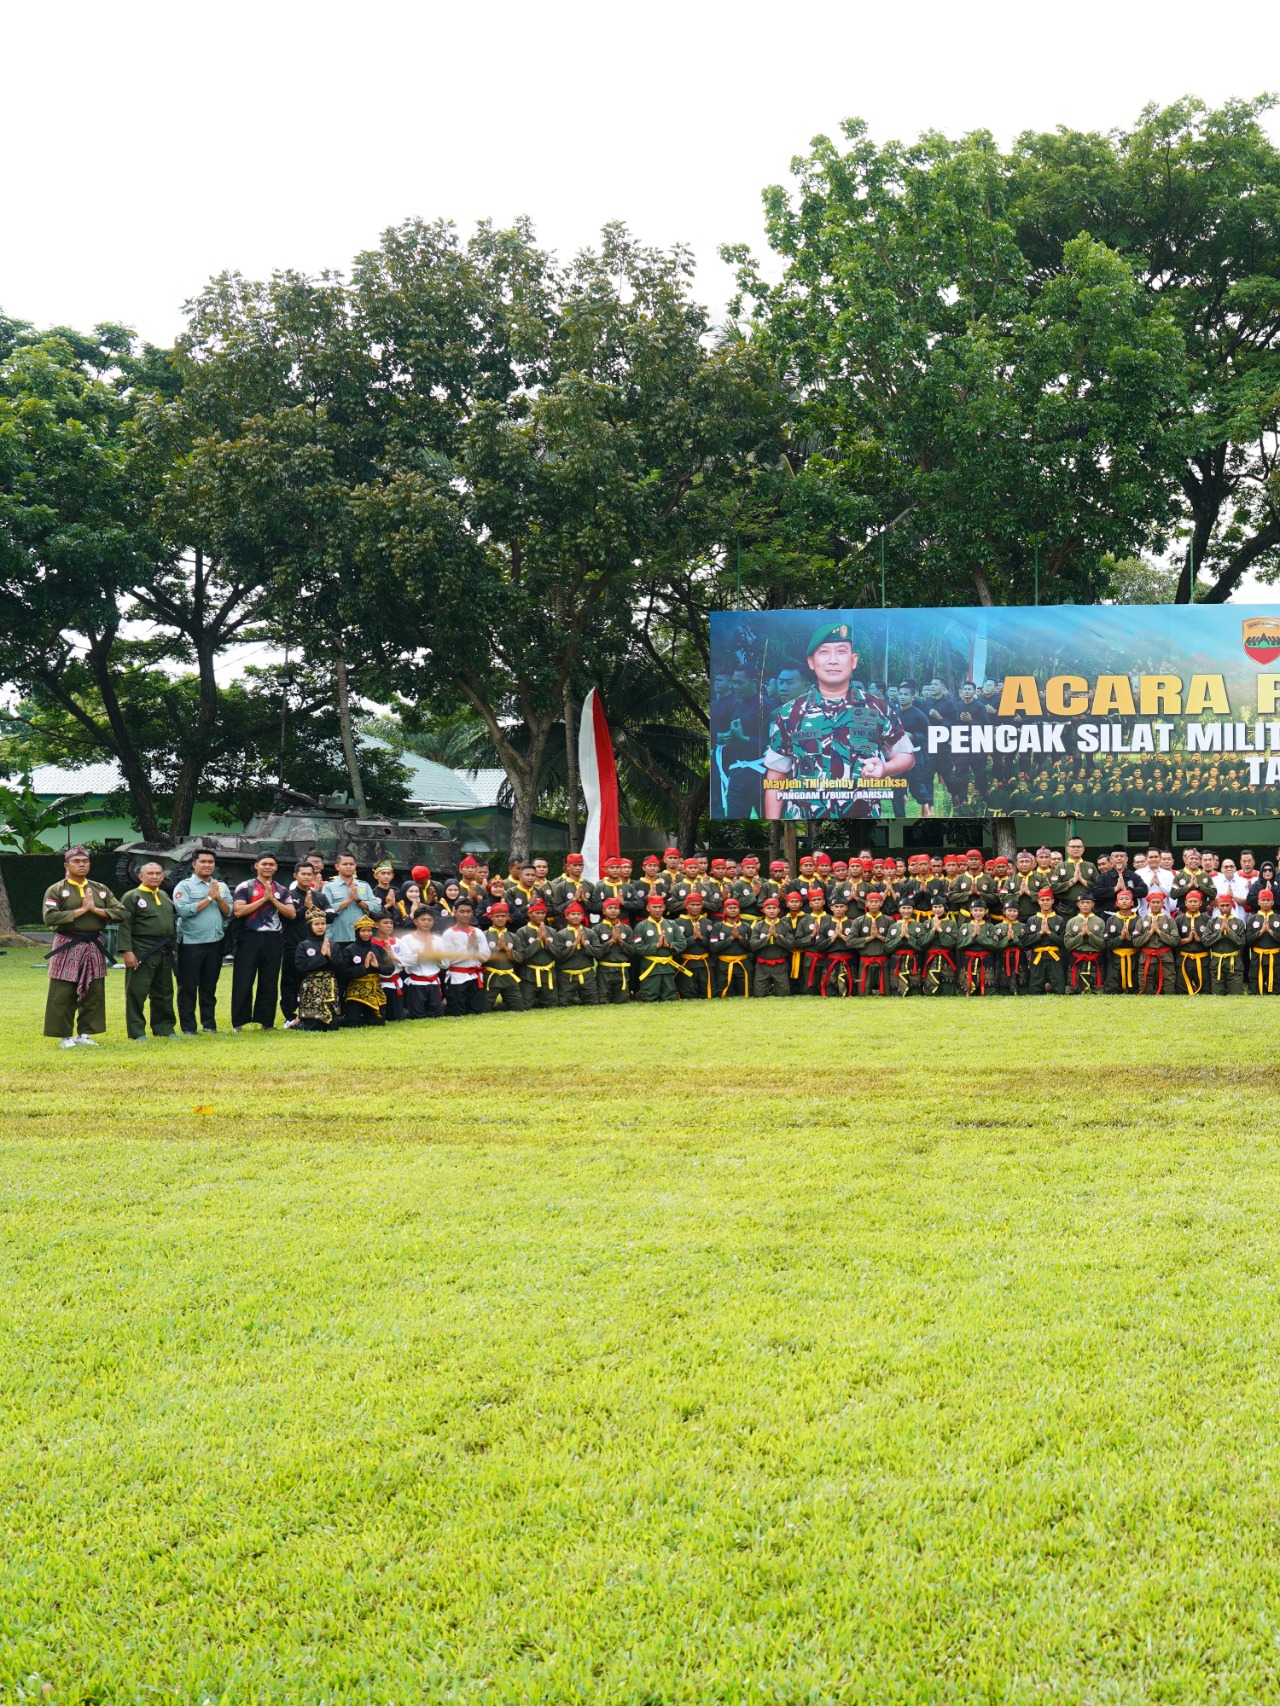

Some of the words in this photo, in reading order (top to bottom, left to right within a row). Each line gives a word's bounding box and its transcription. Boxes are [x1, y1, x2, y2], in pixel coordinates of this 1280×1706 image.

[998, 674, 1231, 716] ACARA
[928, 724, 1066, 753] PENCAK
[1077, 723, 1174, 752] SILAT
[763, 778, 801, 790] Mayjen
[804, 778, 820, 789] TNI
[822, 777, 854, 790] Hendy
[857, 777, 908, 788] Antariksa
[777, 791, 820, 800] PANGDAM
[822, 791, 854, 800] I/BUKIT
[856, 790, 894, 799] BARISAN
